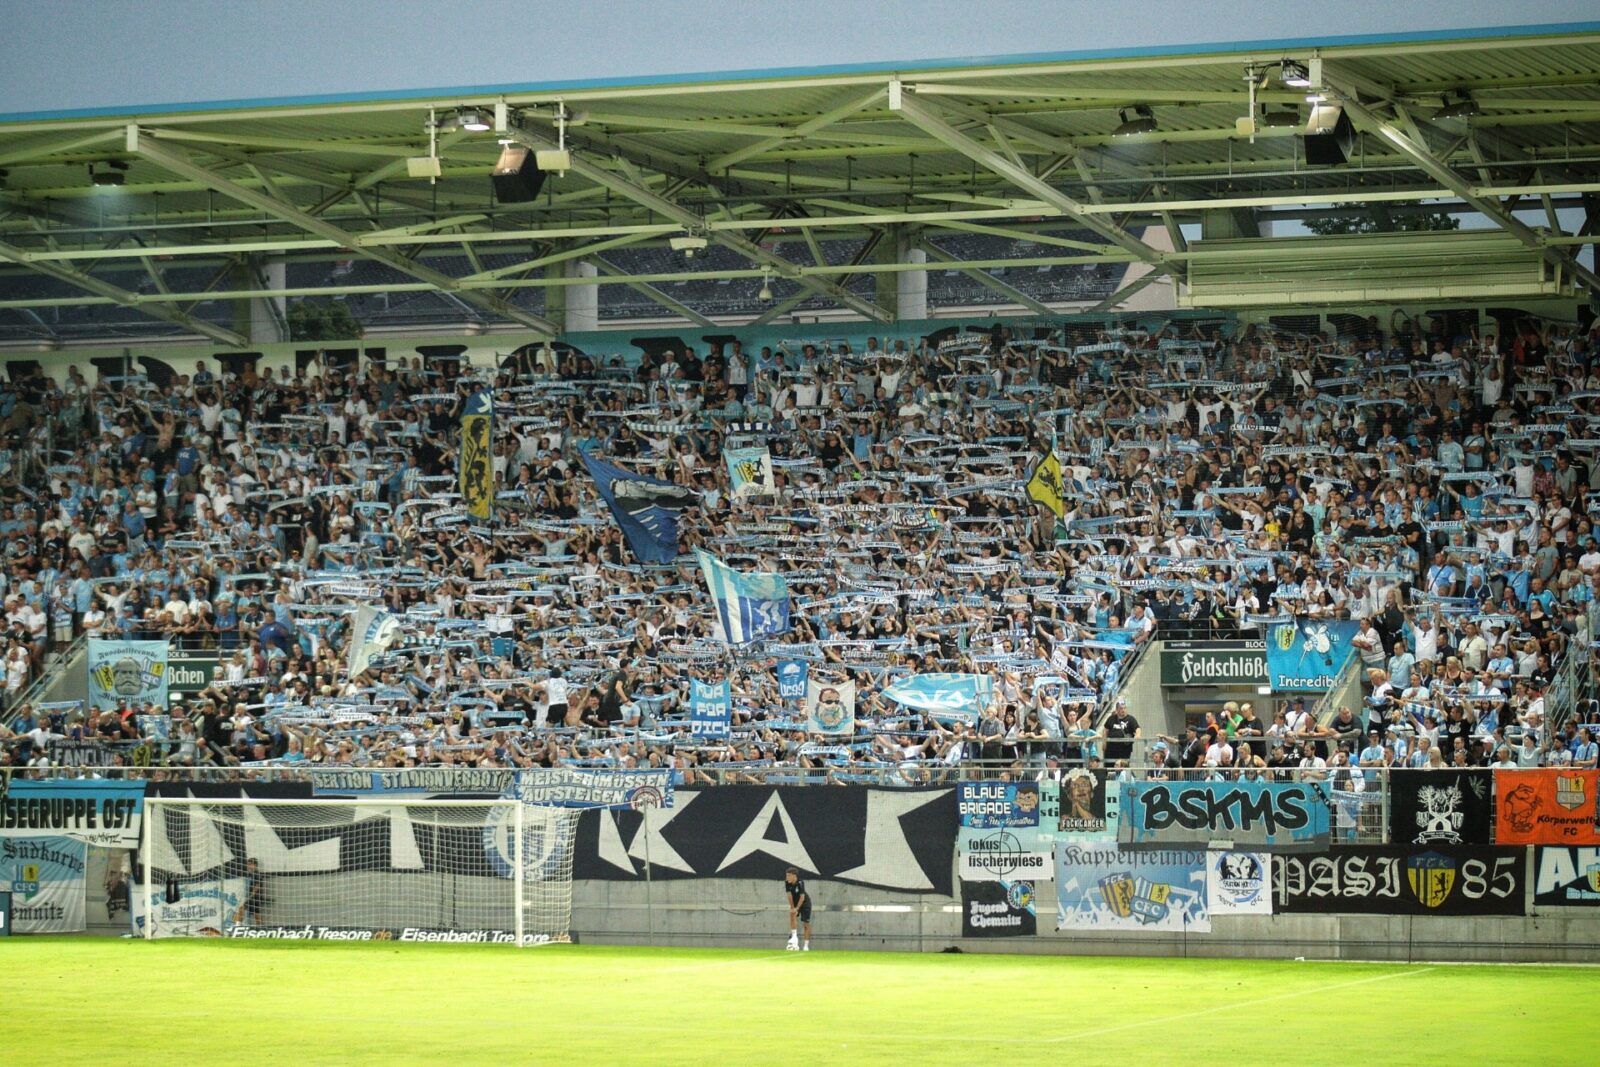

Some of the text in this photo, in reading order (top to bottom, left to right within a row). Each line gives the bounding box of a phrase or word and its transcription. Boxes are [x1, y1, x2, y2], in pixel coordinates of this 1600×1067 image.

[963, 787, 1005, 799] BLAUE
[103, 799, 136, 829] OST
[960, 802, 1012, 814] BRIGADE
[1141, 786, 1309, 836] BSKMS
[968, 838, 1000, 851] fokus
[968, 855, 1043, 867] fischerwiese
[1462, 857, 1516, 898] 85
[11, 903, 65, 921] emnitz
[970, 901, 1009, 915] Jugend
[1133, 900, 1161, 915] CFC
[970, 914, 1022, 928] Chemnitz
[231, 924, 313, 940] Eisenbach
[318, 927, 371, 940] Tresore
[400, 928, 489, 943] Eisenbach
[490, 930, 549, 943] Treore
